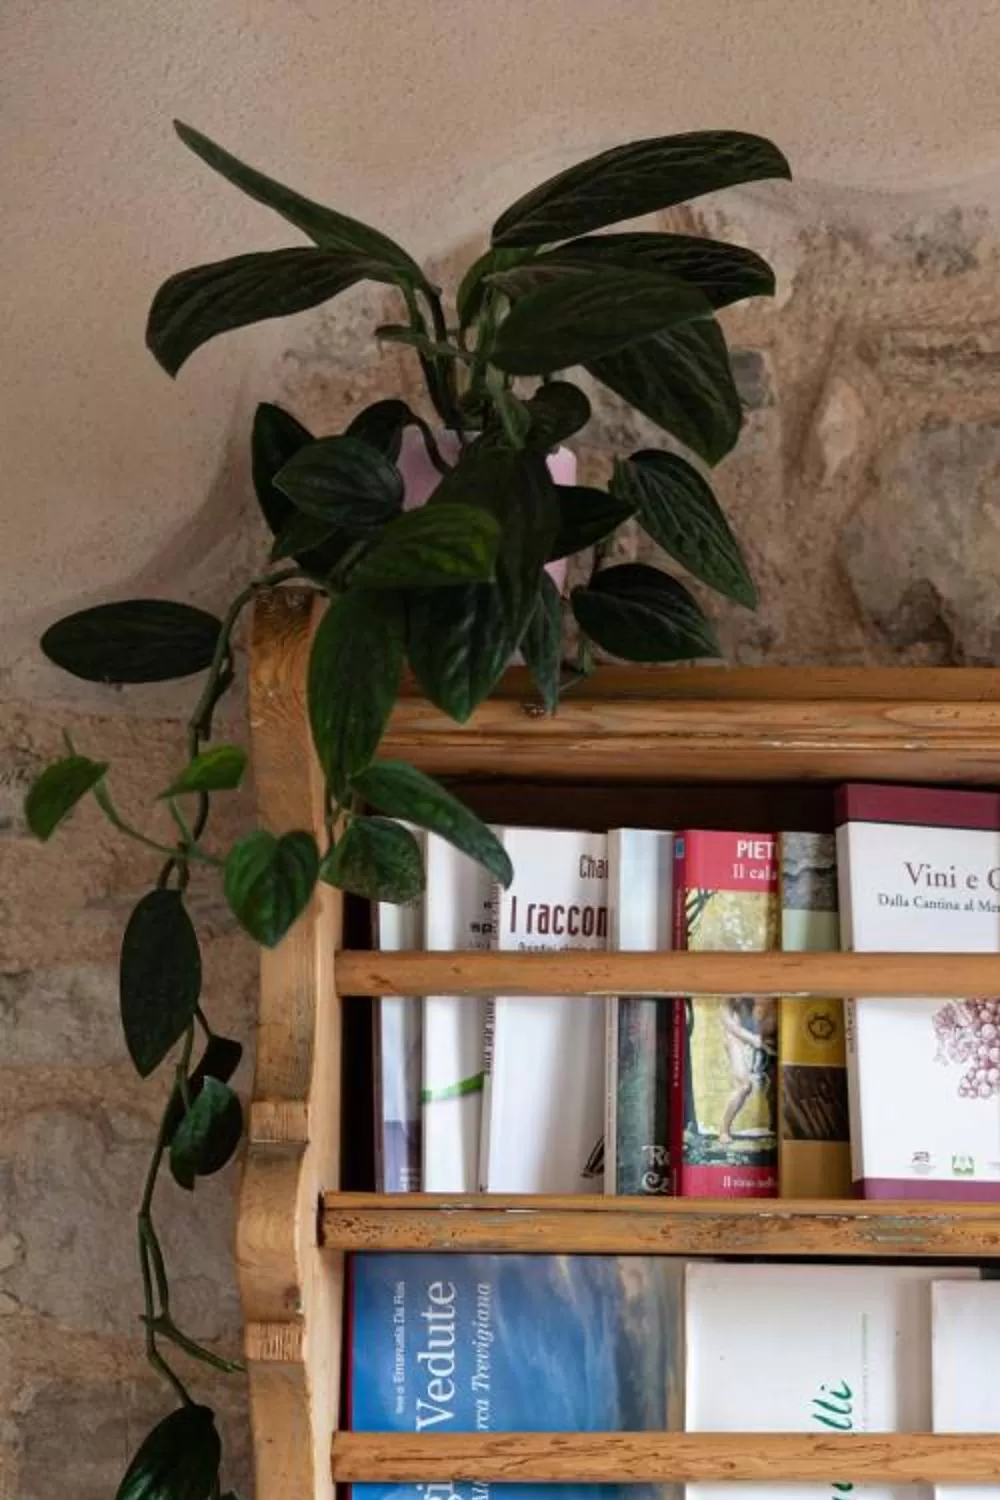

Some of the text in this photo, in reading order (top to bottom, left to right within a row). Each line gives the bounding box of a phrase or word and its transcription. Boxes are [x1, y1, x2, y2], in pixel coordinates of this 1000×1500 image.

[903, 861, 957, 888] Vini
[965, 874, 979, 890] e
[877, 893, 910, 908] Dalla
[913, 895, 960, 911] Cantina
[960, 899, 974, 911] al
[526, 903, 609, 938] raccon
[415, 1279, 457, 1432] Vedute
[471, 1282, 495, 1432] rca Trevigiana
